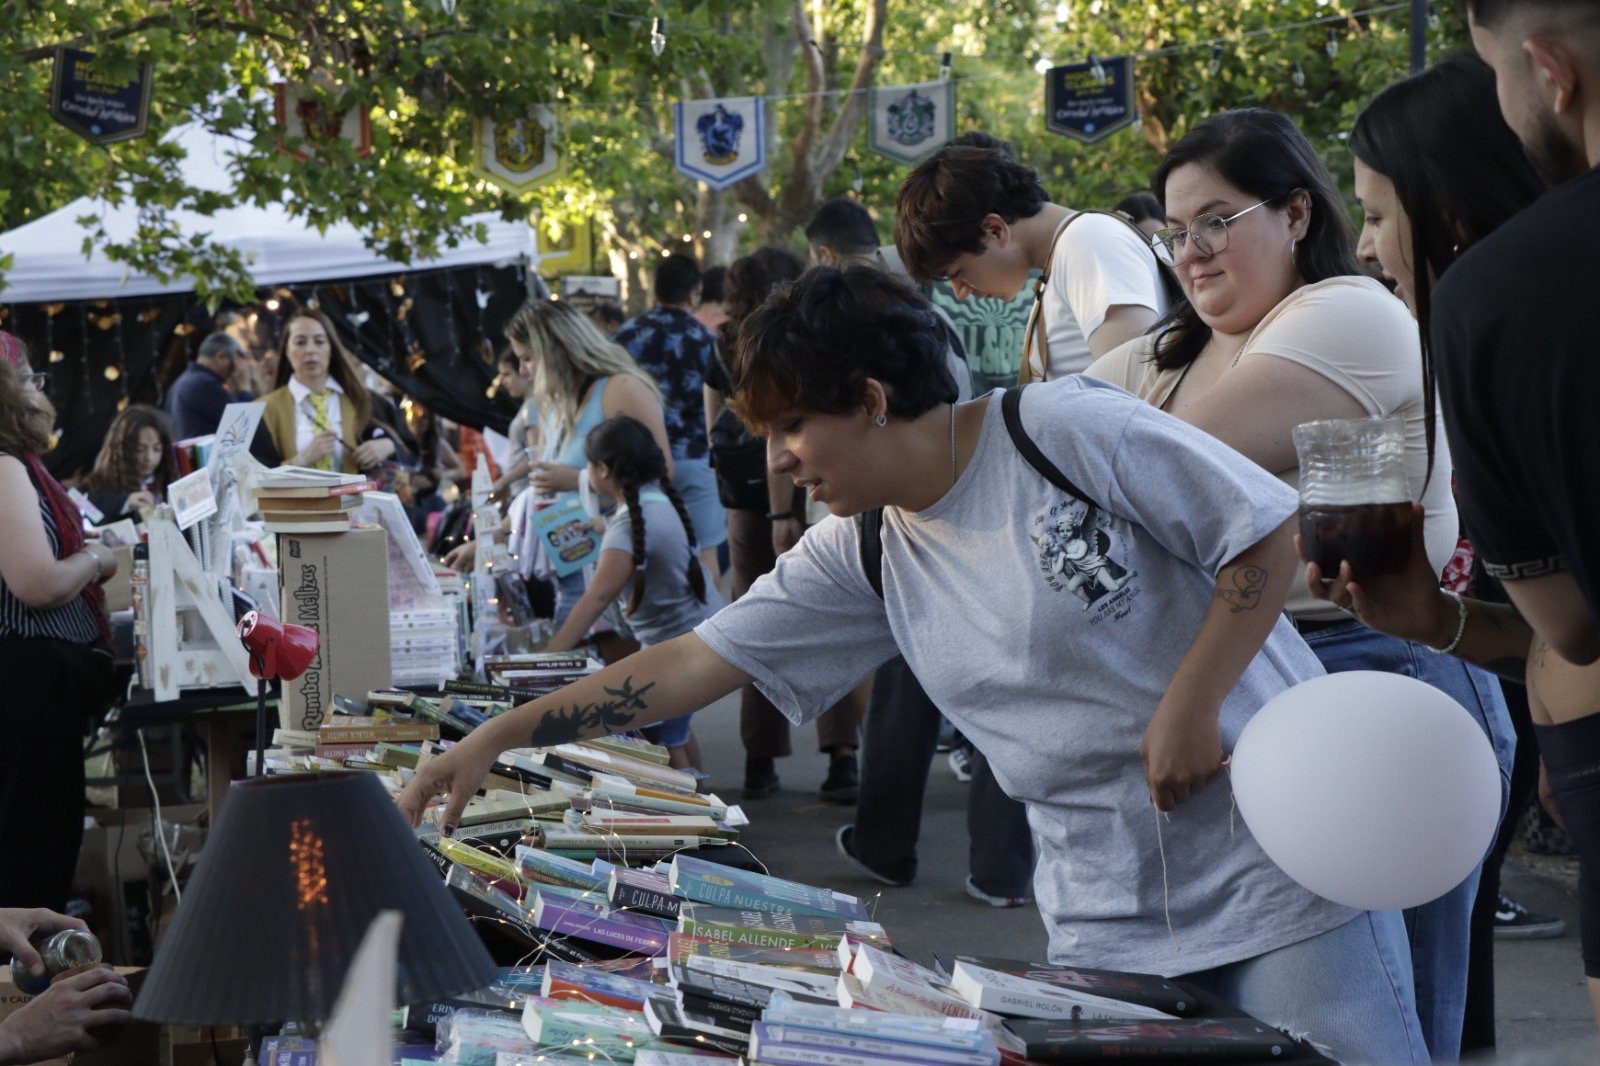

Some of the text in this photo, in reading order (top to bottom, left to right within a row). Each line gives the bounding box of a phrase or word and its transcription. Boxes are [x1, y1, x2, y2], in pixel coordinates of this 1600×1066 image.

[293, 563, 319, 620] Mellizas
[1103, 605, 1116, 617] ARE
[299, 672, 323, 731] Rumba
[326, 730, 375, 740] WILBUR SMITH
[323, 749, 345, 757] SMITH
[631, 889, 664, 908] CULPA
[699, 881, 793, 915] CULPA NUESTRA
[593, 927, 605, 936] LAS
[606, 930, 625, 940] LUCES
[625, 934, 634, 943] DE
[737, 932, 797, 948] ALLENDE
[432, 1003, 455, 1015] ERIN
[941, 1001, 983, 1020] VENTANA
[1000, 996, 1034, 1008] GABRIEL
[1035, 1000, 1064, 1013] ROLÓN
